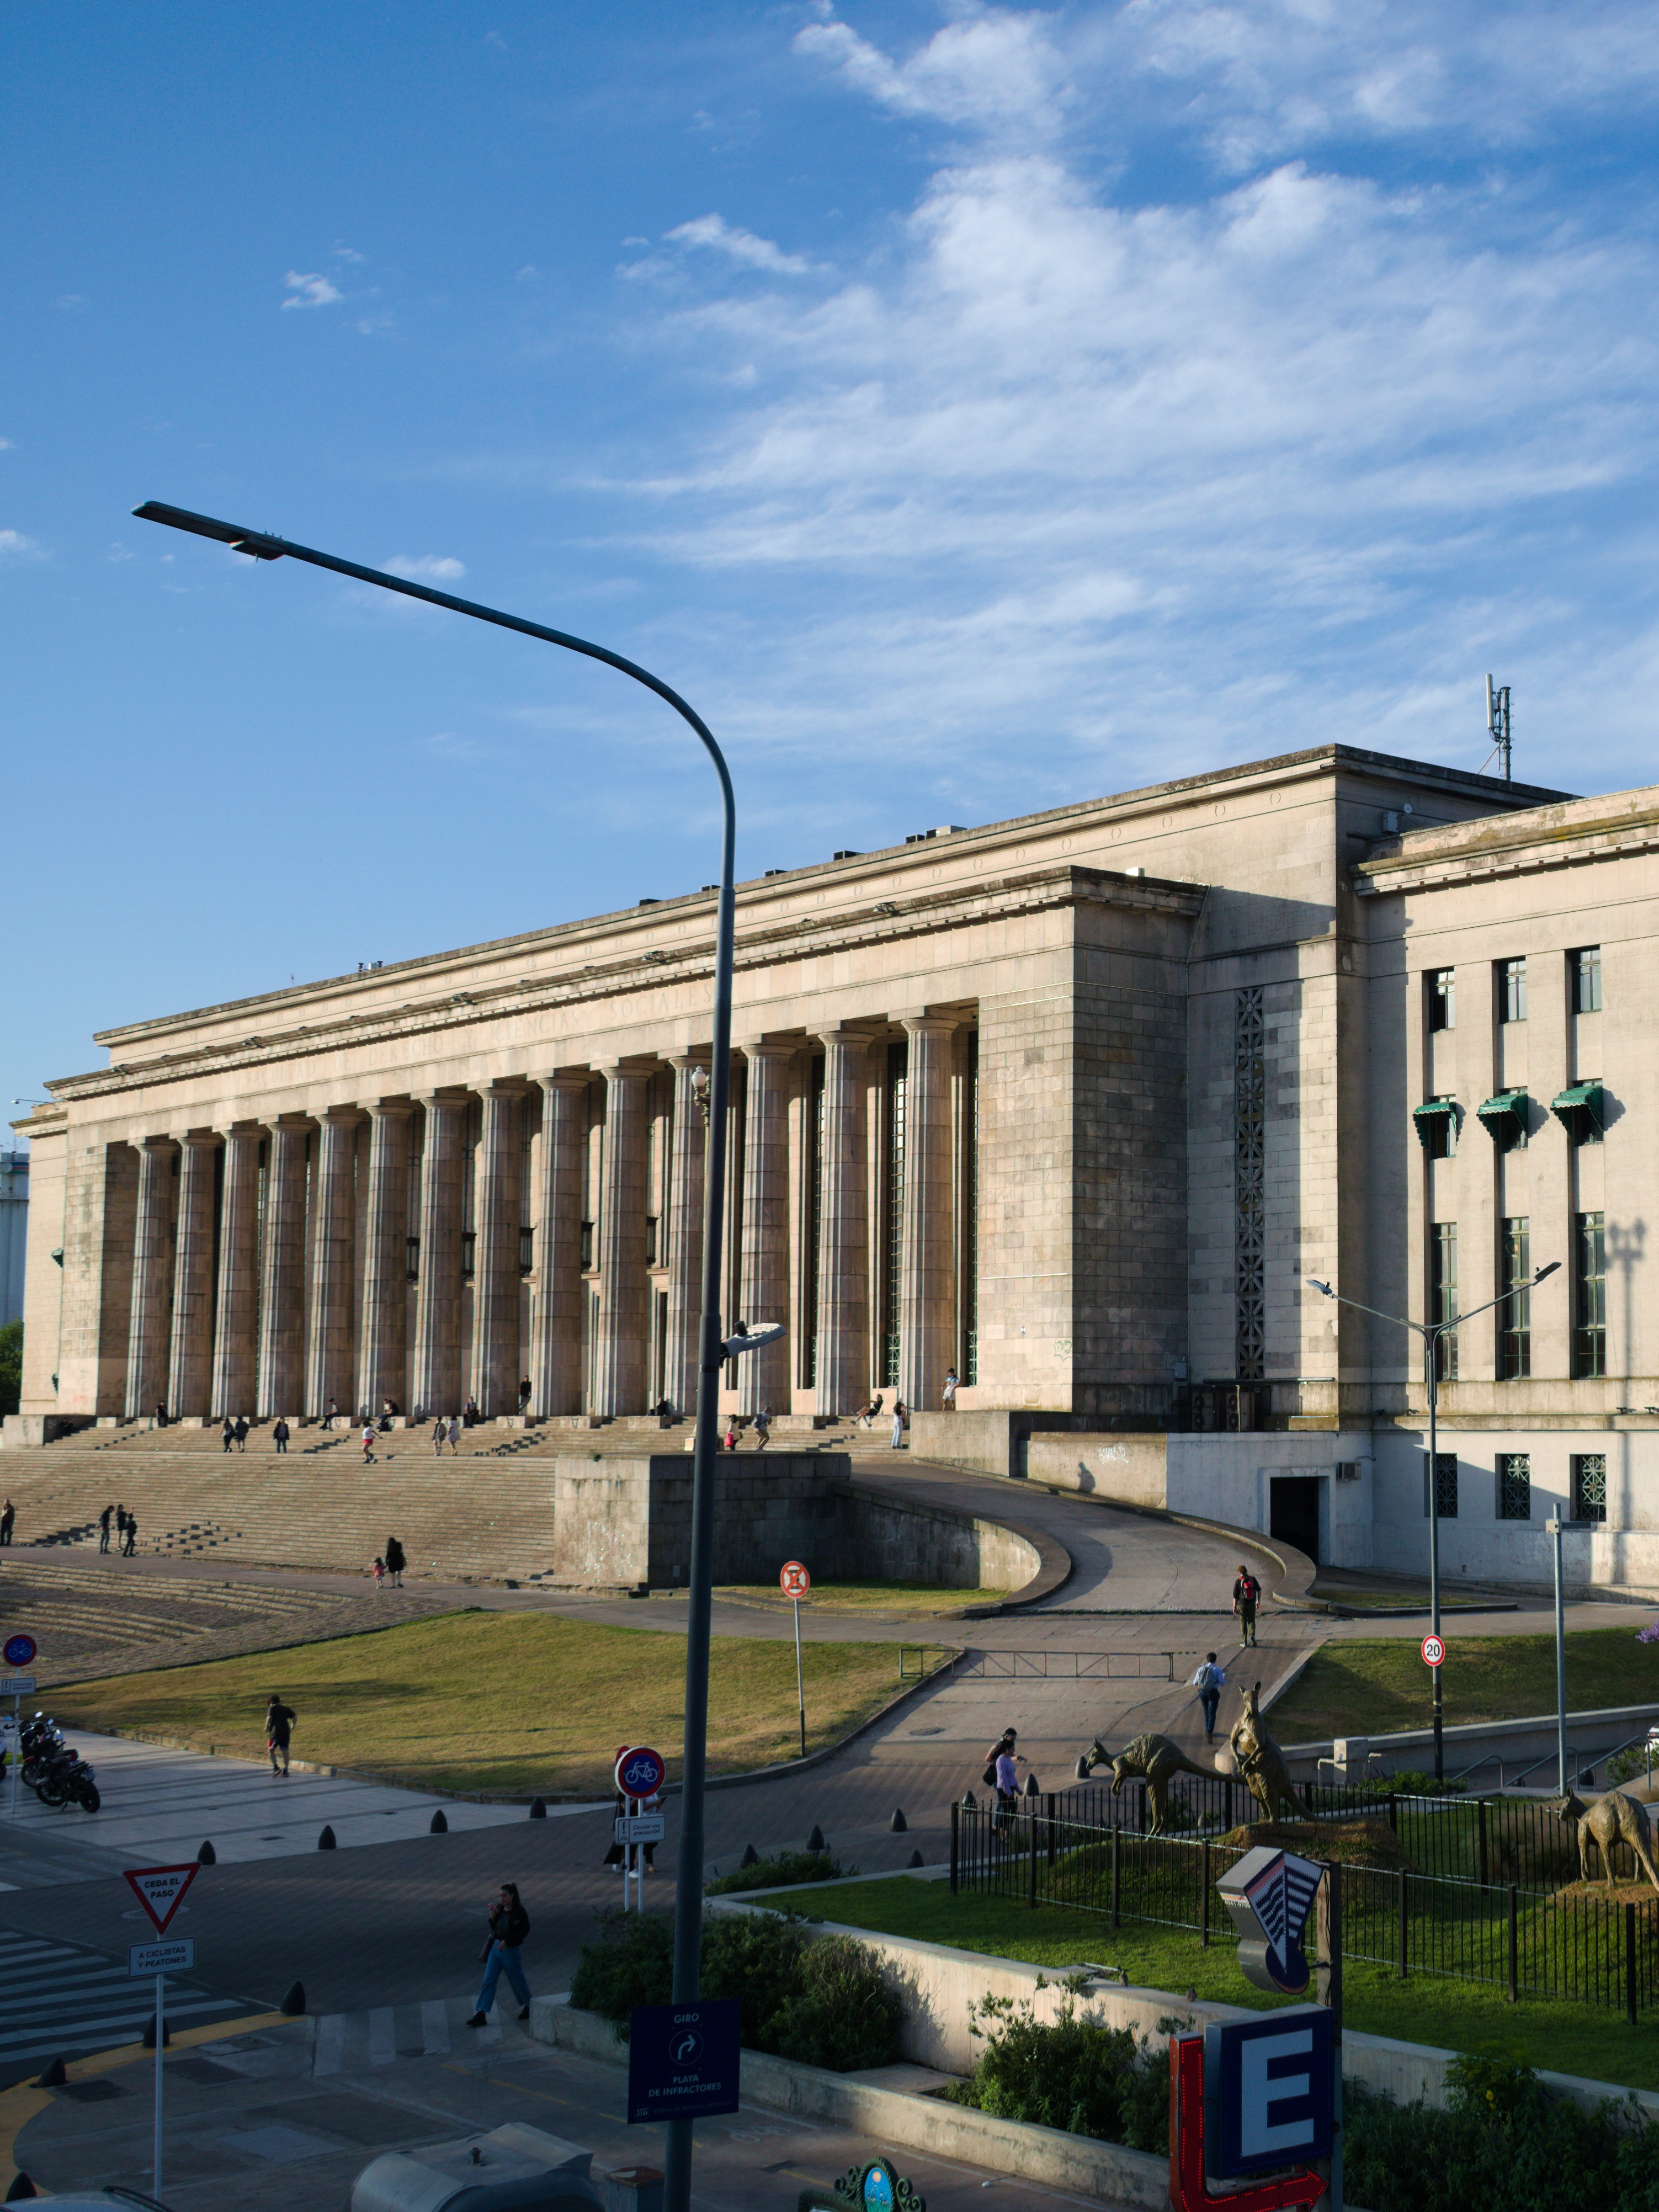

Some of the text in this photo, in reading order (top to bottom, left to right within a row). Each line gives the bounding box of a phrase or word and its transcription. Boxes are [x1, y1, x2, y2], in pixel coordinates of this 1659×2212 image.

[246, 1059, 316, 1086] FACULTAD
[333, 1051, 354, 1072] DE
[369, 1035, 444, 1066] DERECHO
[494, 1011, 579, 1042] CIENCIAS
[609, 982, 712, 1020] SOCIALES
[1427, 1644, 1440, 1657] 20
[145, 1879, 168, 1888] CEDA
[151, 1889, 174, 1899] PASO
[146, 1945, 187, 1958] CICLISTAS
[145, 1955, 187, 1968] PEATONES
[674, 2013, 699, 2023] GIRO
[673, 2074, 699, 2084] PLAYA
[648, 2082, 722, 2097] DE INFRACTORES
[1241, 2029, 1314, 2158] E
